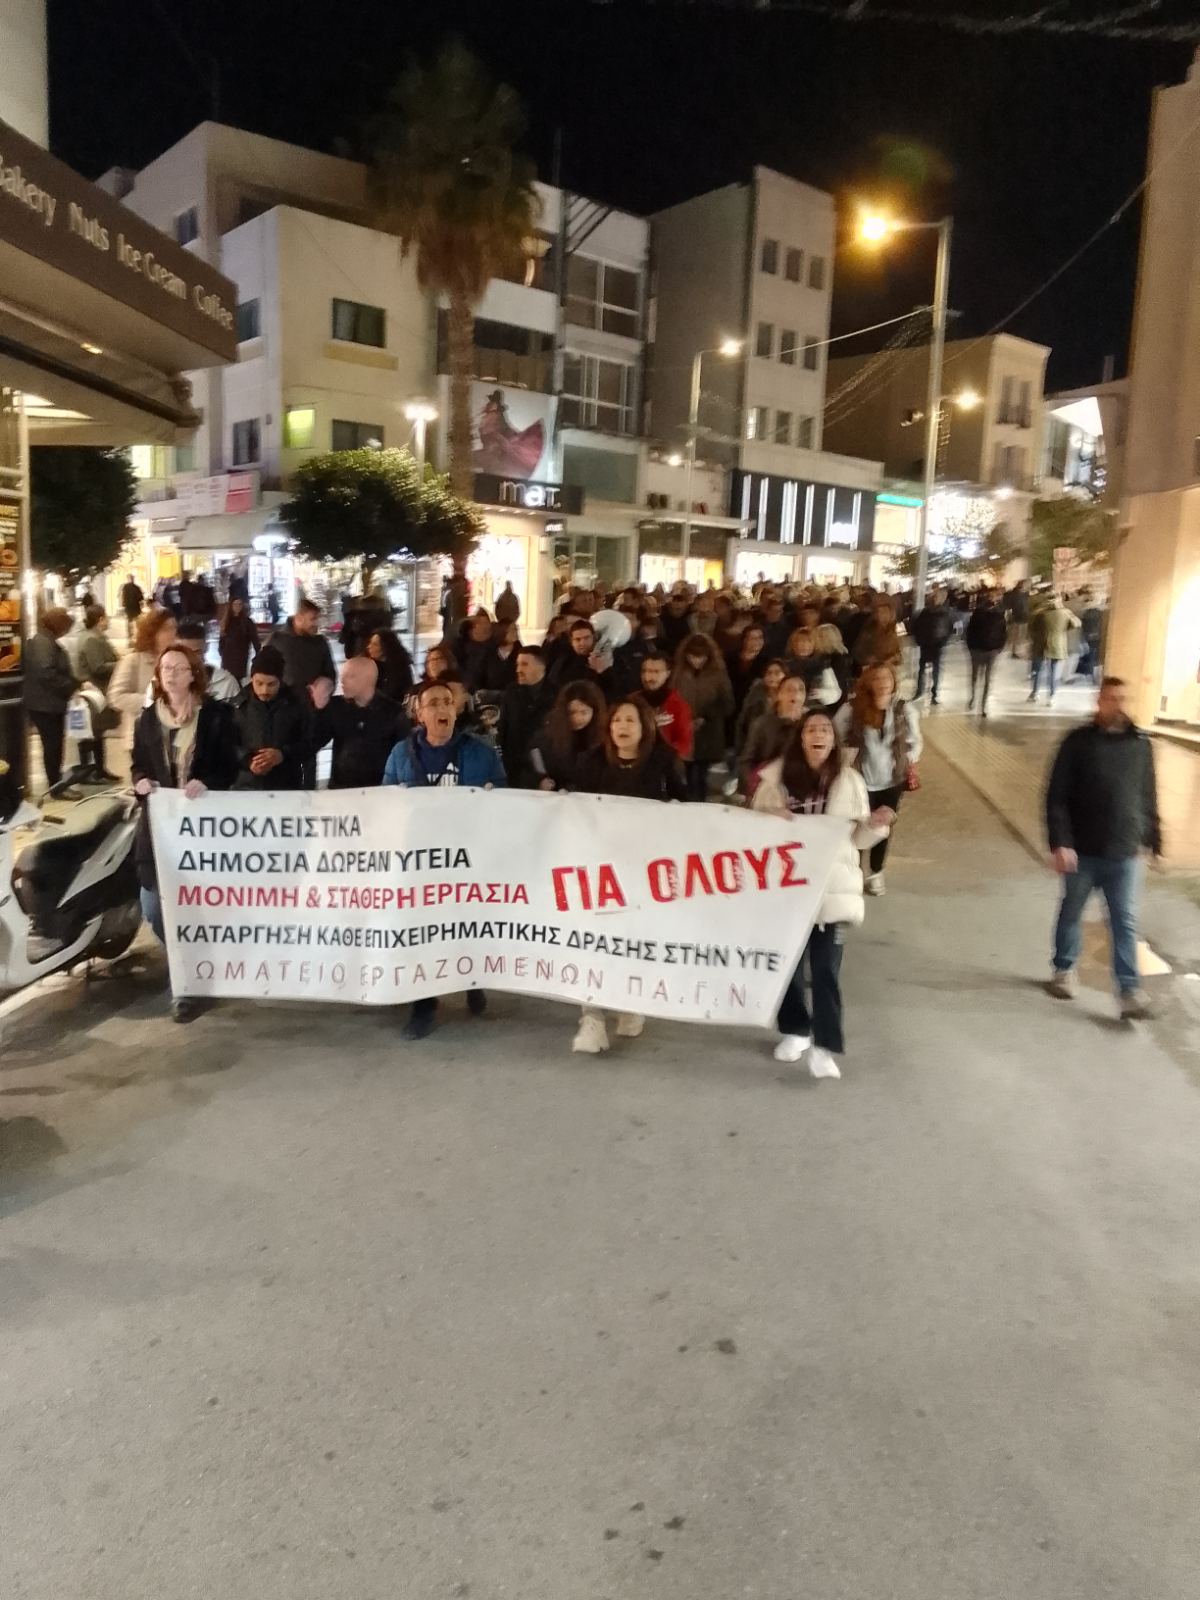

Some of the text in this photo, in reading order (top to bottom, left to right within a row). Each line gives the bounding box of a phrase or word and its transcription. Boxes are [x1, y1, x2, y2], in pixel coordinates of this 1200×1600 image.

[68, 201, 110, 251] Nuts
[143, 252, 187, 300] Cream
[179, 815, 361, 838] ΑΠΟΚΛΕΙΣΤΙΚΑ
[178, 848, 471, 873] ΔΗΜΟΣΙΑ ΔΩΡΕΑΝ ΥΓΕΙΑ
[552, 841, 807, 911] ΓΙΑ ΟΛΟΥΣ
[177, 883, 530, 910] ΜΟΝΙΜΗ & ΣΤΑΘΕΡΗ ΕΡΓΑΣΙΑ
[177, 924, 311, 946] ΚΑΤΑΡΓΗΣΗ
[317, 926, 363, 947] ΚΑΘΕ
[364, 921, 561, 949] ΕΠΙΧΕΙΡΗΜΑΤΙΚΗΣ
[567, 930, 657, 962] ΔΡΑΣΗΣ
[663, 942, 730, 967] ΣΤΗΝ
[360, 954, 603, 987] ΕΡΓΑΖΟΜΕΝΩΝ
